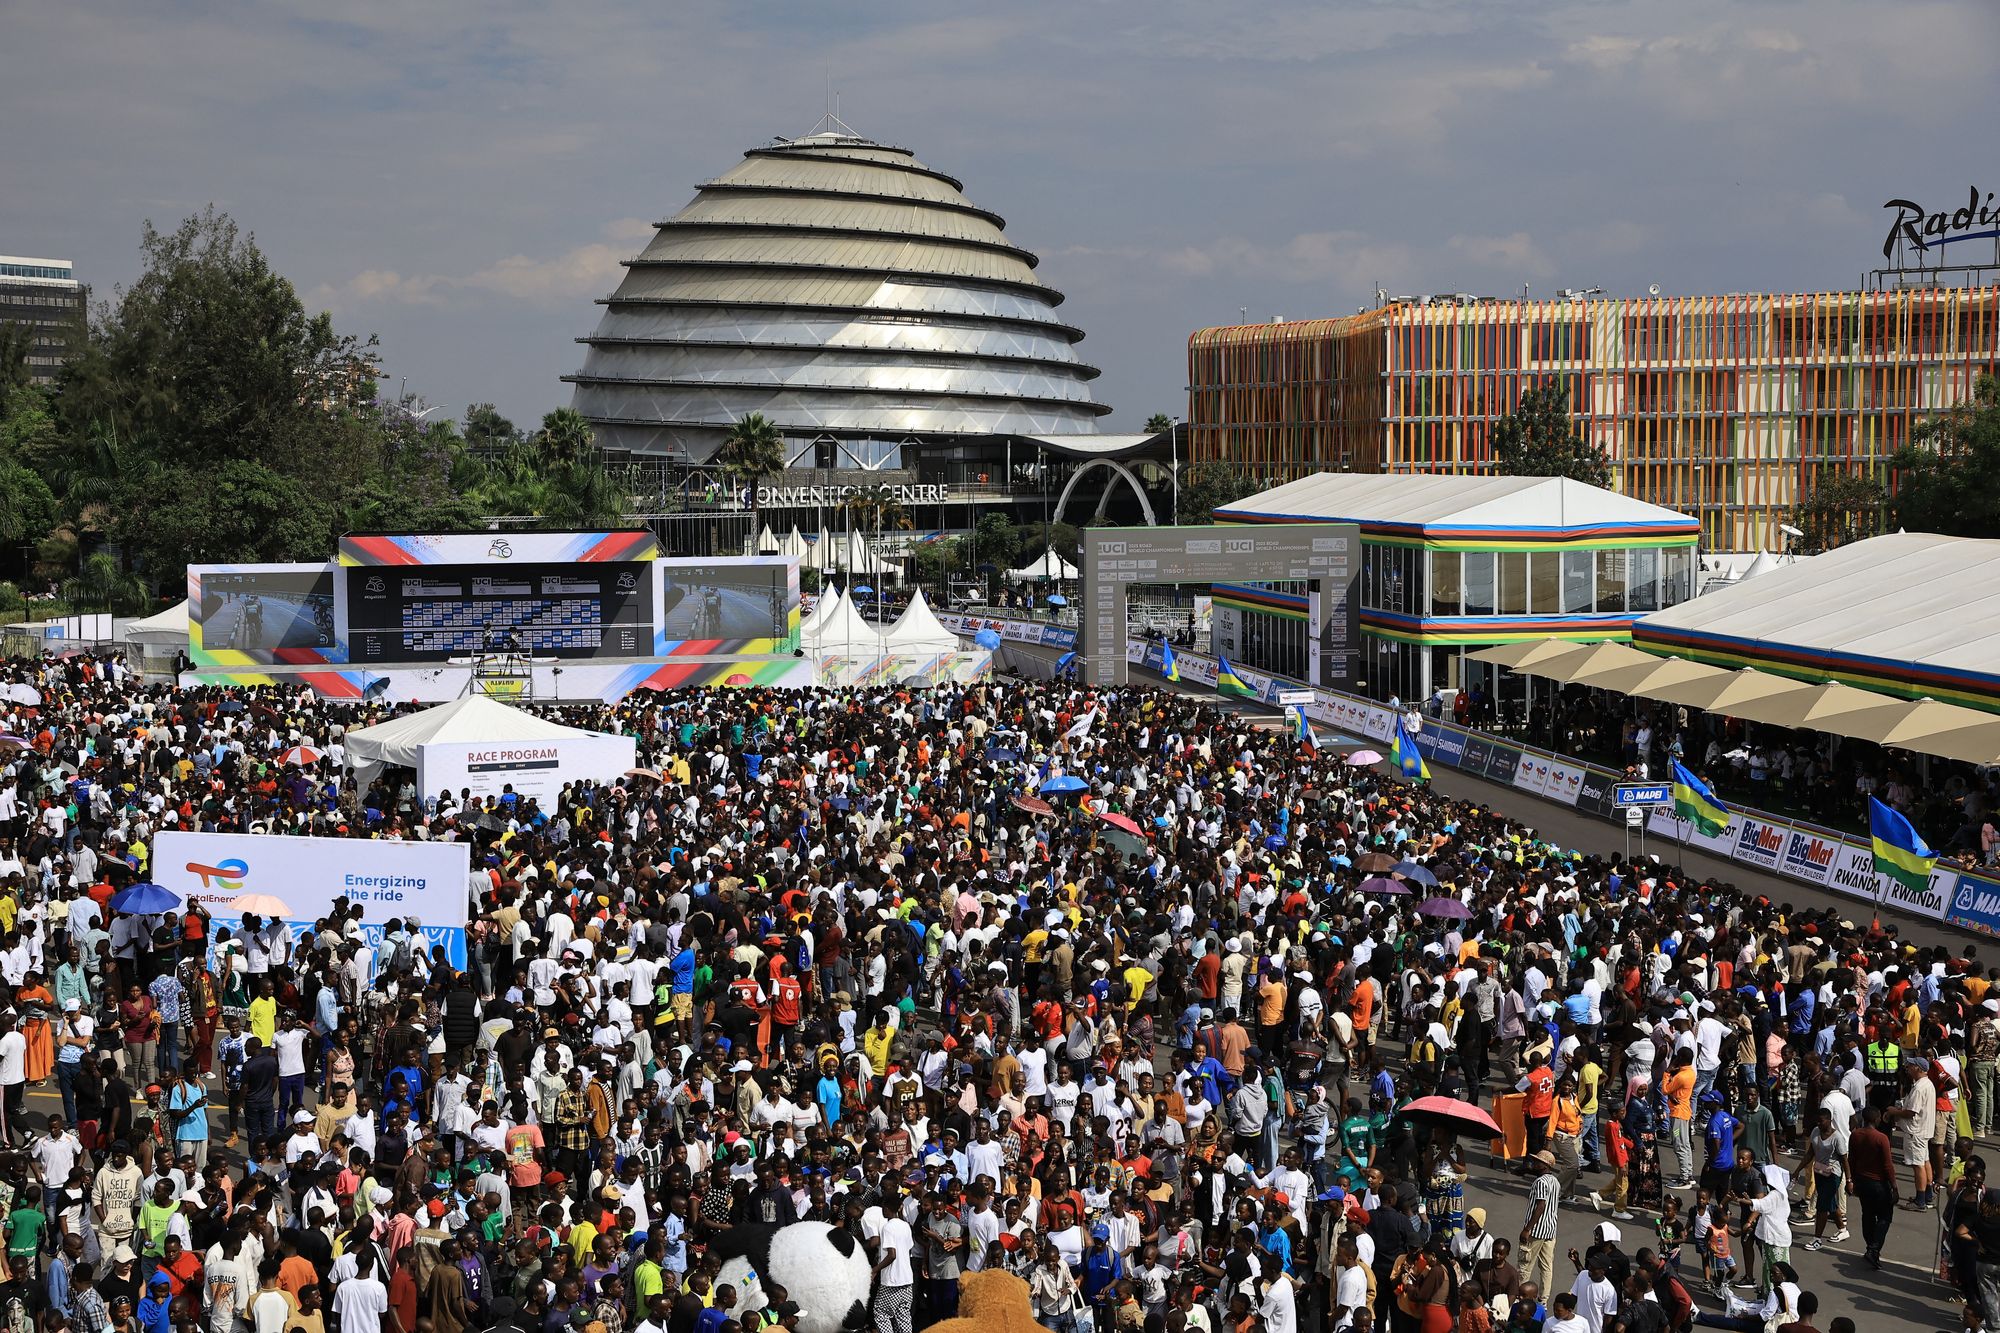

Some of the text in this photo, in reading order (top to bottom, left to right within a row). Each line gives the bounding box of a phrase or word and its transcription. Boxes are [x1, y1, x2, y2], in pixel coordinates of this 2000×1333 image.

[741, 484, 948, 504] CONVENTIO CENTRE
[1103, 544, 1125, 553] UCI
[1230, 541, 1252, 551] UCI
[1438, 738, 1462, 754] SHIMANO
[468, 748, 558, 762] RACE PROGRAM
[1581, 784, 1602, 800] Santini
[1635, 790, 1663, 800] MAPEI
[1740, 820, 1783, 851] BigMat
[1736, 849, 1749, 857] HOME
[1755, 853, 1775, 866] BUILDERS
[1788, 833, 1834, 866] BigMat
[1851, 854, 1874, 873] VISI
[1783, 864, 1798, 872] HOME
[1803, 868, 1825, 881] BUILDERS
[345, 873, 427, 889] Energizing
[1834, 868, 1881, 895] RWANDA
[345, 888, 404, 902] the ride
[1891, 883, 1942, 911] RWANDA
[1115, 1117, 1132, 1140] 23
[110, 1179, 130, 1190] SELF
[114, 1214, 124, 1223] 42
[471, 1278, 479, 1291] 2
